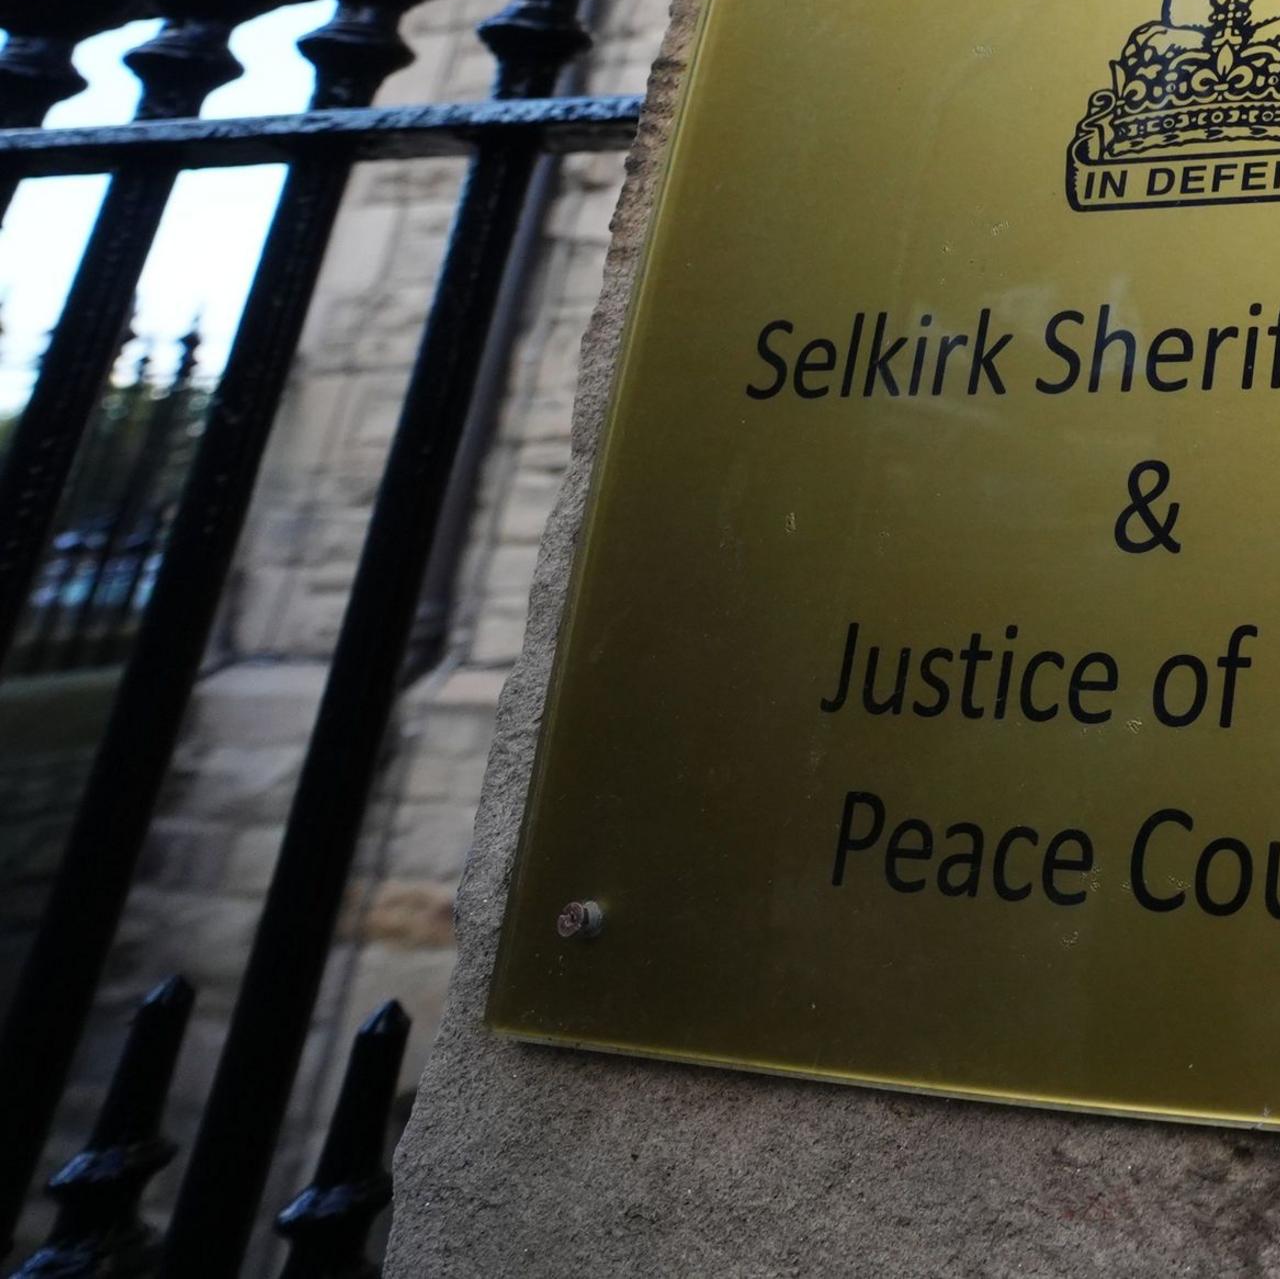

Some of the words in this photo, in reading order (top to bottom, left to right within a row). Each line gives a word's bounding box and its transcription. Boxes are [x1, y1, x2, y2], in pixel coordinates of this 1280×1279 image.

[1083, 169, 1129, 200] IN
[746, 307, 1014, 401] Selkirk
[1113, 459, 1182, 555] &
[819, 621, 1119, 725] Justice
[1152, 623, 1259, 729] of
[831, 790, 1094, 907] Peace
